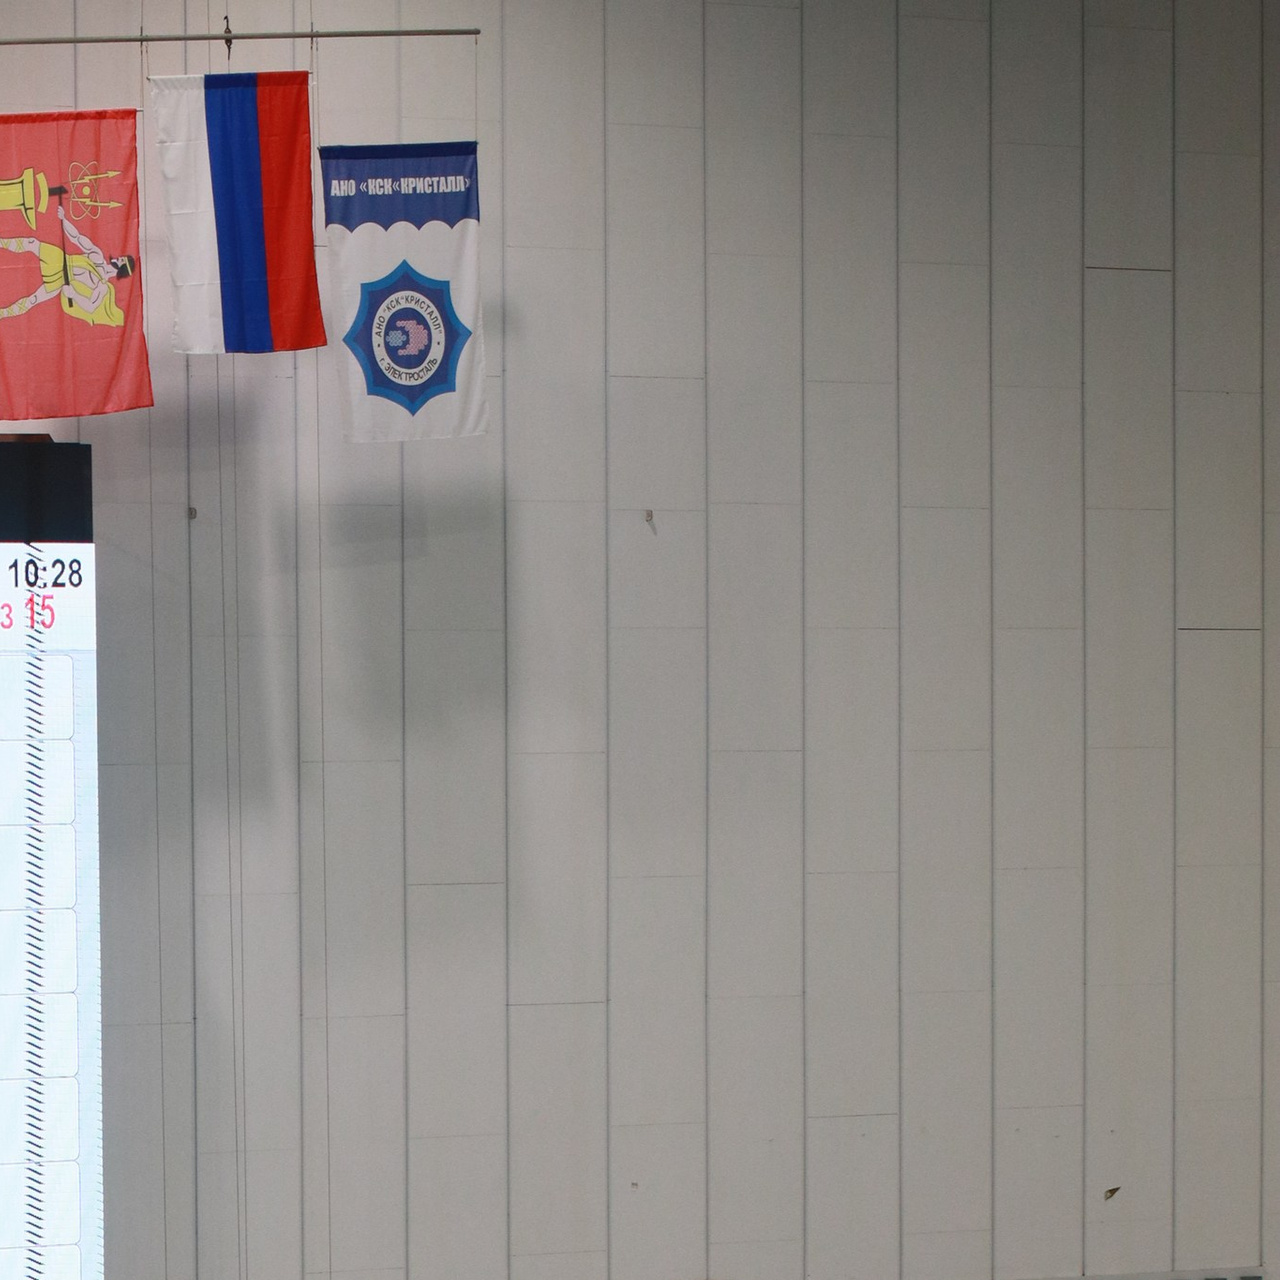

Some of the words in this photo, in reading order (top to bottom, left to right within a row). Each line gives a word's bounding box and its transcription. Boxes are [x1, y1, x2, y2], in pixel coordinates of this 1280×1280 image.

[330, 179, 356, 196] АНО
[375, 315, 386, 337] АНО
[8, 559, 83, 588] 10:28
[25, 593, 55, 629] 15
